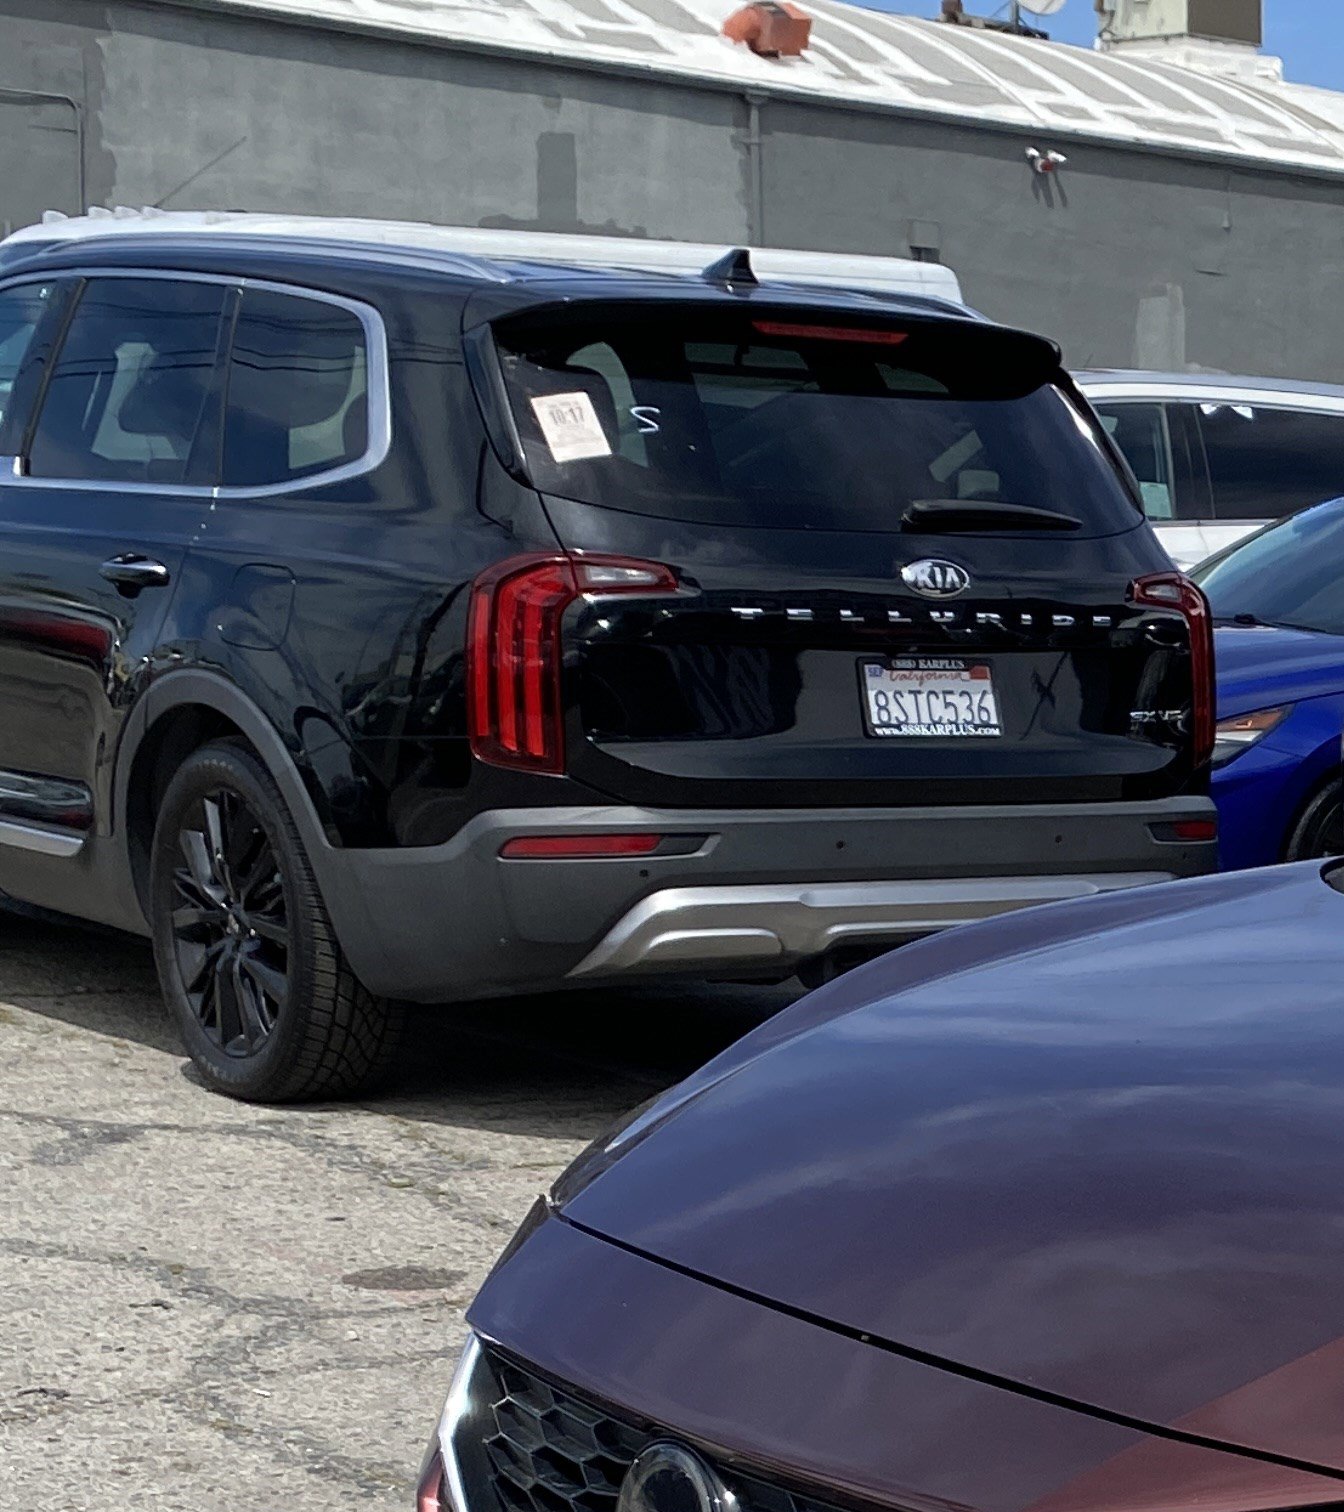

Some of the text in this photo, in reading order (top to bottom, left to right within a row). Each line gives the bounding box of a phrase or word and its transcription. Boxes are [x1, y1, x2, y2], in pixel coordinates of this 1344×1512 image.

[916, 563, 961, 589] KIA
[731, 606, 1111, 627] TELLURIDE
[918, 660, 965, 670] KARPLUS
[874, 690, 991, 725] 8STC536
